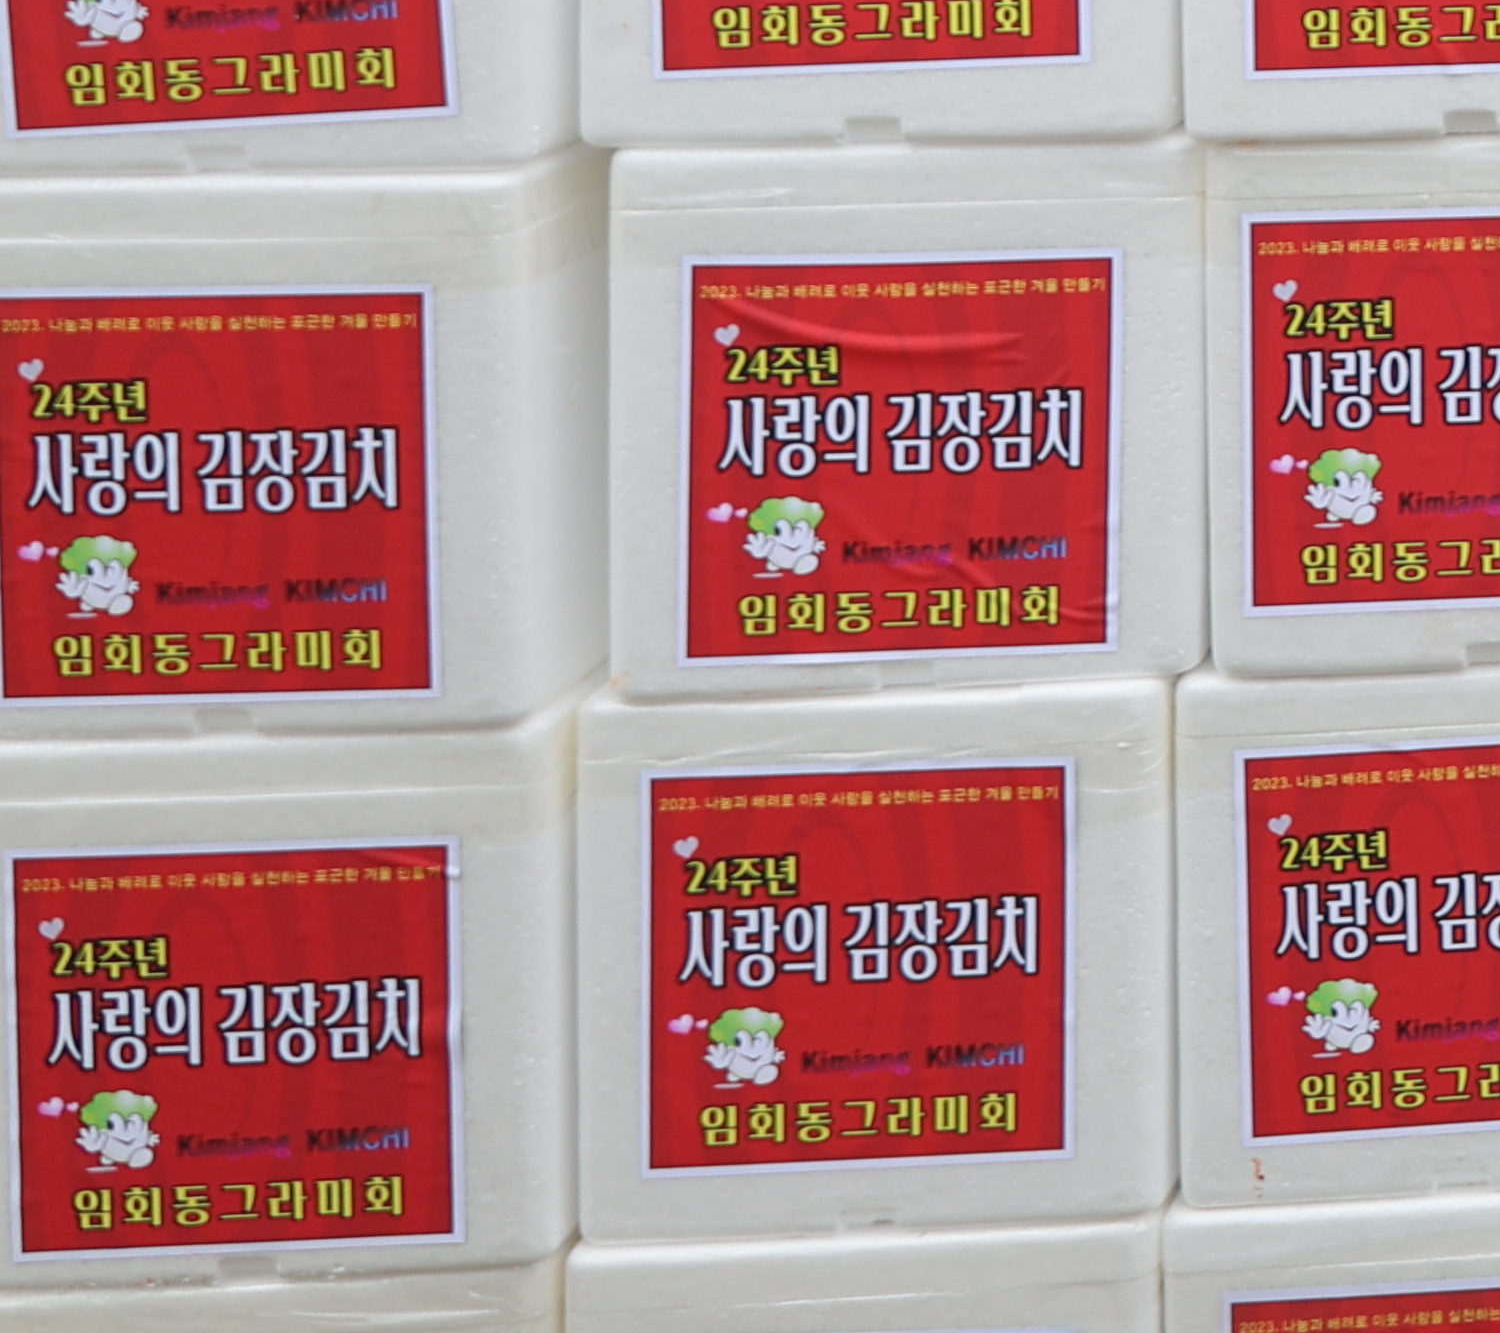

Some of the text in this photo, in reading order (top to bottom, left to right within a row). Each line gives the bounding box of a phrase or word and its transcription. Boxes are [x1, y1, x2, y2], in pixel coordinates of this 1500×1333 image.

[65, 47, 396, 107] 임회동그라미회
[1285, 298, 1394, 341] 24주년
[32, 379, 147, 423] 24주년
[1279, 347, 1423, 430] 사랑의
[28, 426, 399, 516] 사랑의 김장김치
[53, 628, 382, 678] 임회동그라미회
[685, 854, 798, 897] 24주년
[679, 895, 1038, 988] 사랑의 김장김치
[699, 1092, 1017, 1148] 임회동그라미회
